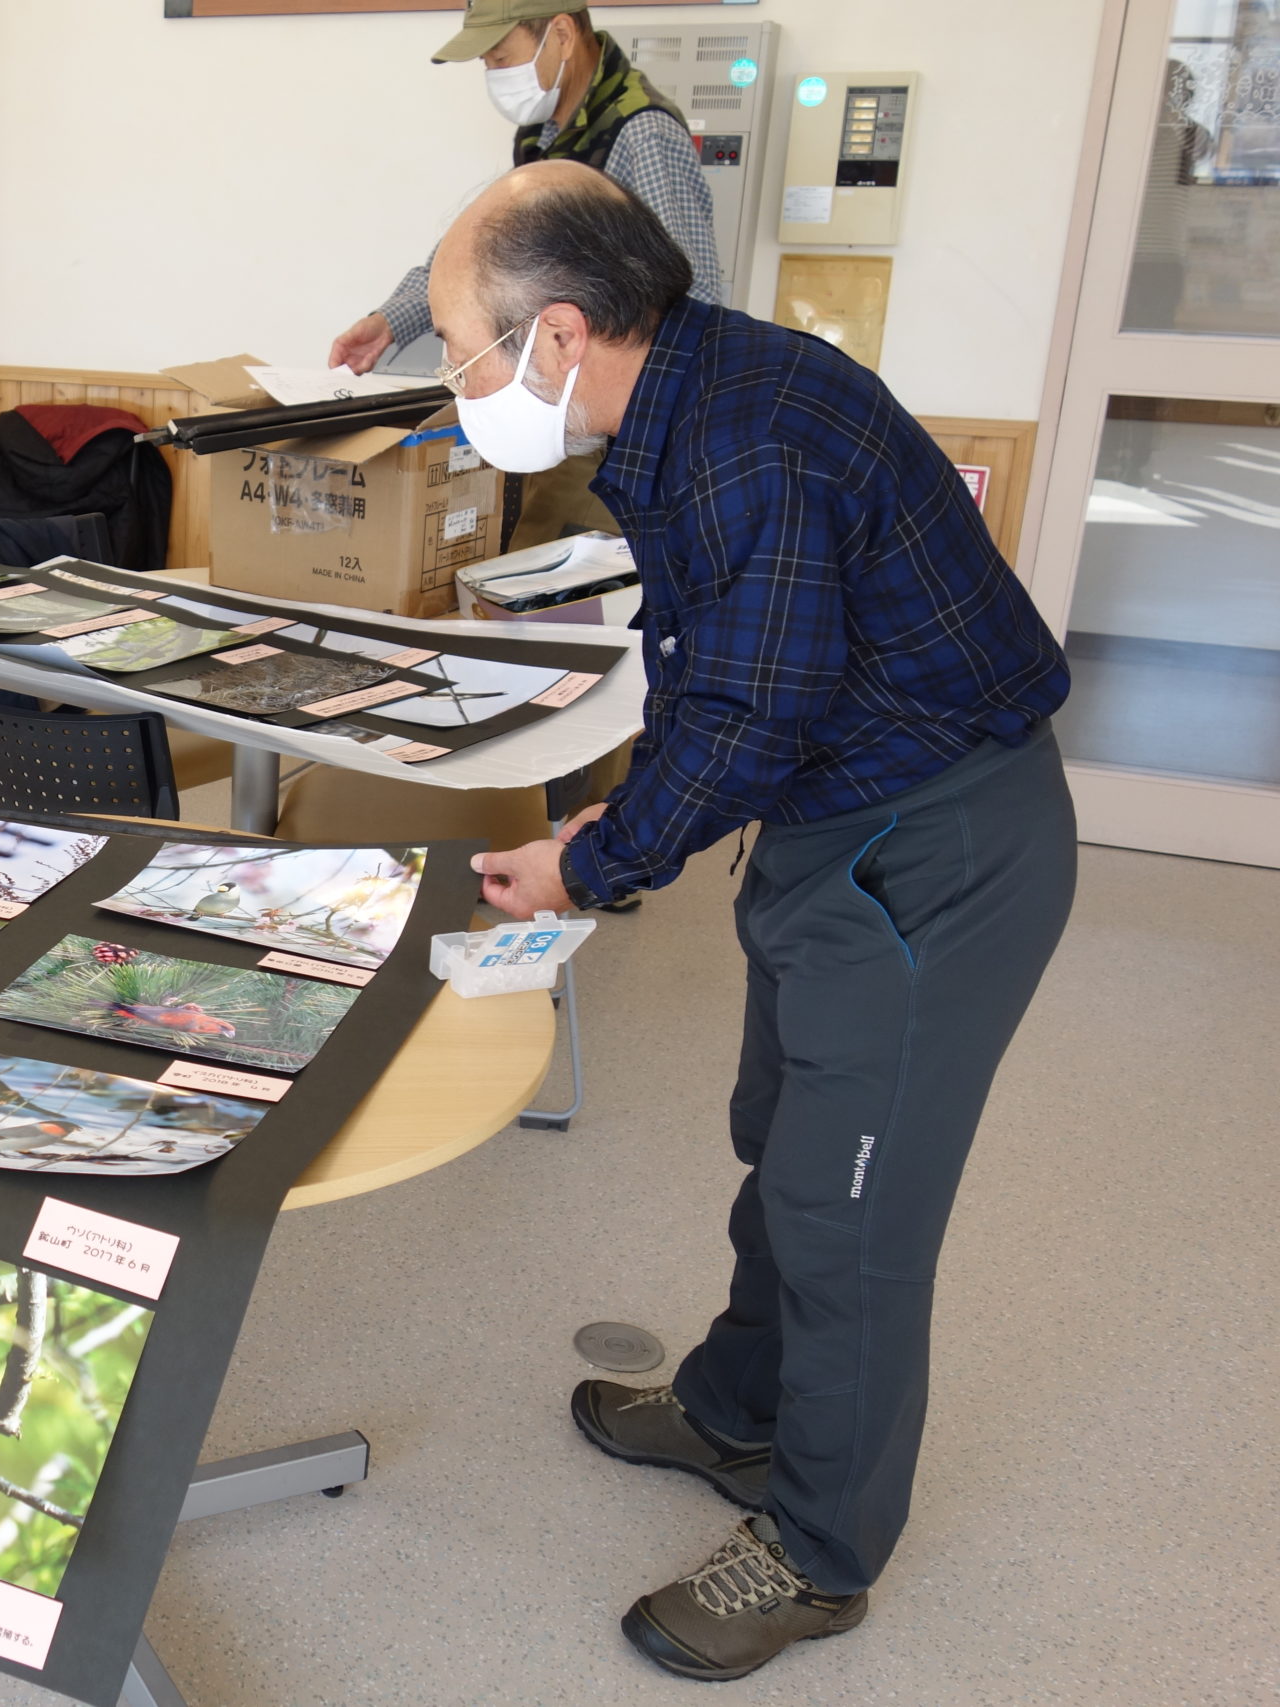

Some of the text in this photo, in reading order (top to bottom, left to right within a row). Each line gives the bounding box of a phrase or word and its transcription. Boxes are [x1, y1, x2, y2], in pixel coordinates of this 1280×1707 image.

[339, 556, 362, 571] 12入
[312, 568, 332, 578] MADE
[344, 574, 365, 583] CHINA
